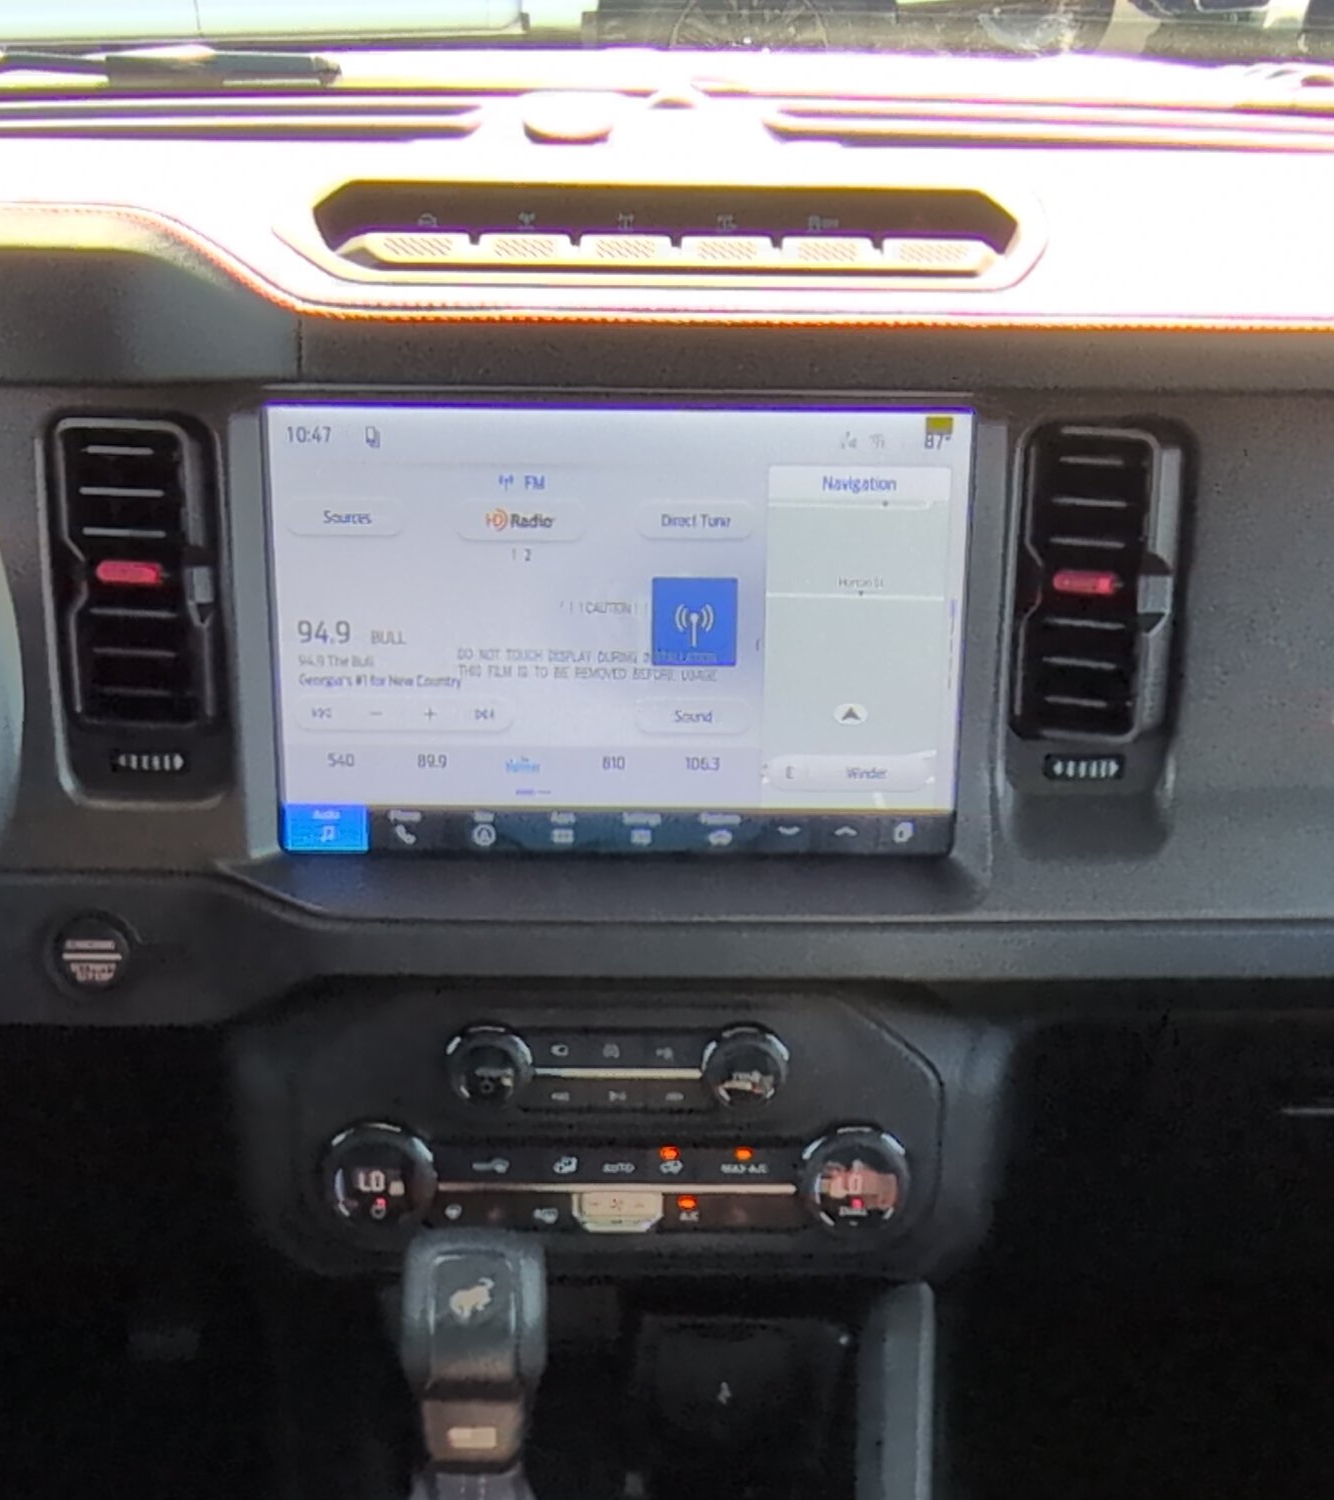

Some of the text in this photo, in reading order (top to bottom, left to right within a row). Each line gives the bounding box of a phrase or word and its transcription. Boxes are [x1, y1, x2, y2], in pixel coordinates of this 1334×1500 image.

[286, 426, 331, 443] 10:47
[524, 475, 545, 490] FM
[822, 475, 897, 493] Navigation
[323, 510, 372, 525] Sources
[510, 513, 555, 529] Radio
[661, 513, 731, 529] Direct Tune
[524, 548, 532, 562] 2
[297, 619, 351, 644] 94.9
[370, 630, 406, 645] BULL
[674, 709, 713, 724] Sound
[327, 753, 355, 767] 540
[357, 1170, 386, 1193] LO
